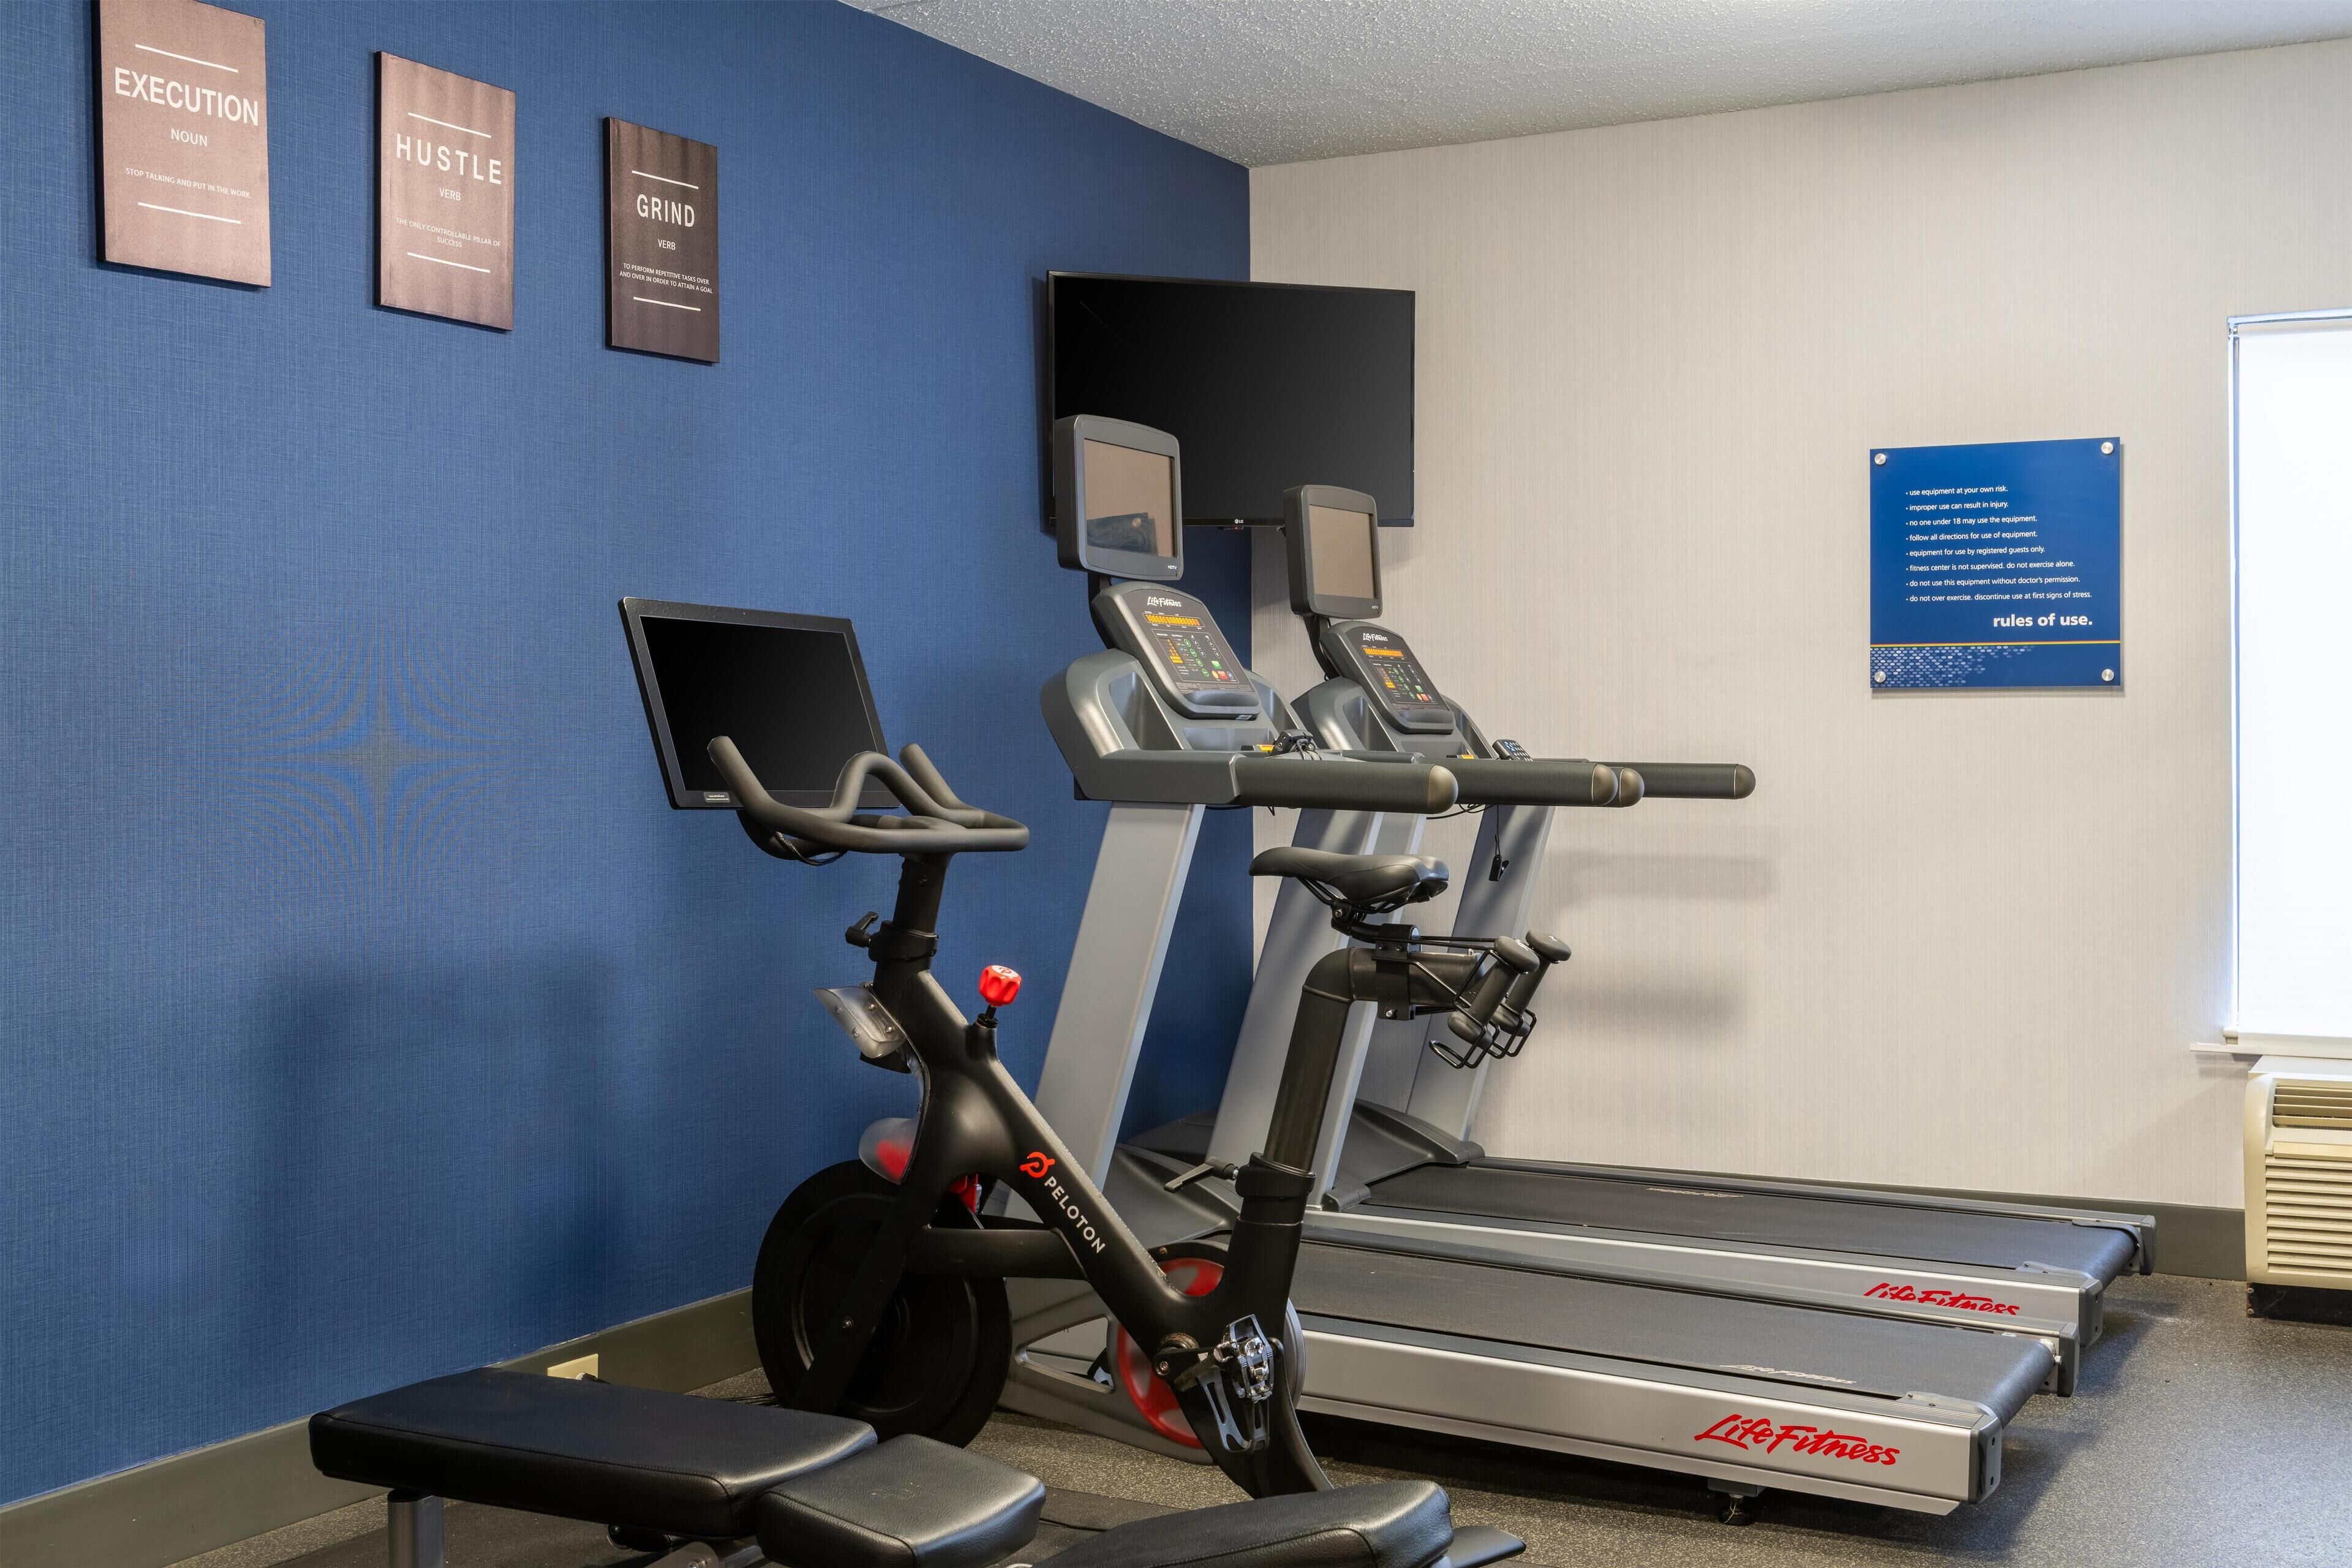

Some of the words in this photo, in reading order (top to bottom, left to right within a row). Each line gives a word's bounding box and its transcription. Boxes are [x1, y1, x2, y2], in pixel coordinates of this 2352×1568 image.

[115, 67, 258, 126] EXECUTION
[171, 128, 207, 146] NOUN
[396, 133, 502, 184] HUSTLE
[126, 167, 143, 176] STOP
[145, 171, 175, 183] TALKING
[176, 178, 191, 187] AND
[216, 186, 228, 194] THE
[439, 187, 461, 200] VERB
[637, 194, 694, 227] GRIND
[409, 221, 425, 229] ONLY
[427, 225, 471, 240] CONTROLLABLE
[473, 236, 491, 245] PILLAR
[437, 236, 462, 247] SUCCESS
[658, 239, 675, 250] VERB
[631, 264, 654, 274] PERFORM
[655, 269, 680, 279] REPETITIVE
[1977, 546, 2007, 555] registered
[1970, 562, 2004, 570] supervised.
[2044, 575, 2080, 584] permission.
[1993, 614, 2033, 627] rules
[2037, 612, 2055, 626] of
[2060, 616, 2092, 625] use.
[1044, 1176, 1106, 1254] PELOTON
